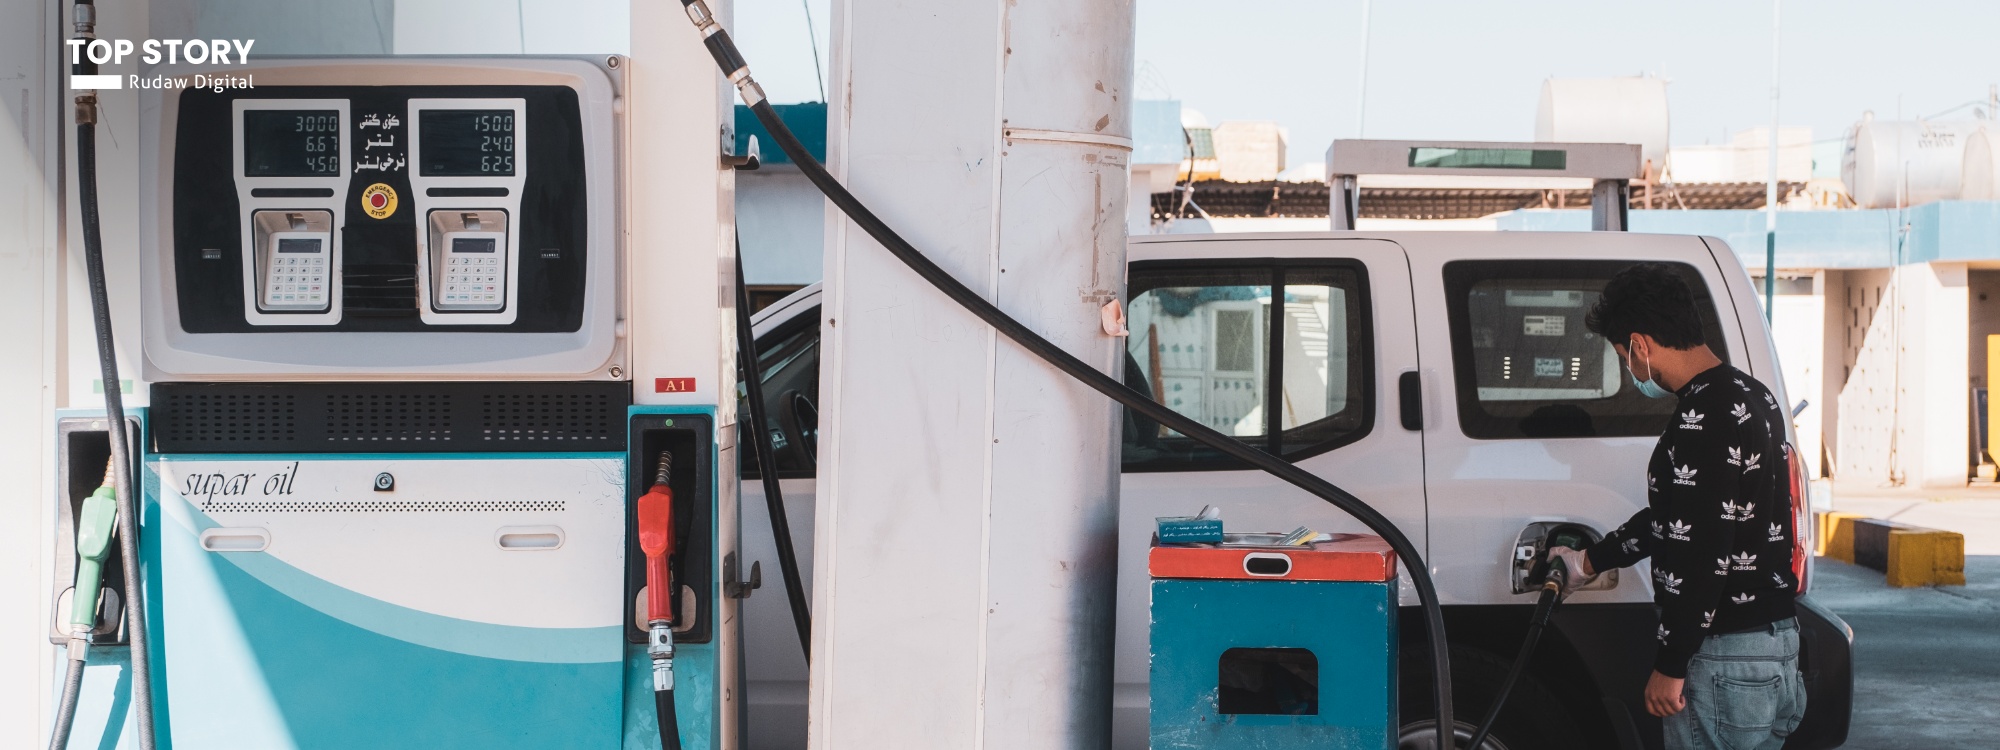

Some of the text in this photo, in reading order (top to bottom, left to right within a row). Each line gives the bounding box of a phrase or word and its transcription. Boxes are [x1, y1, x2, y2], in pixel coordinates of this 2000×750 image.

[295, 115, 338, 132] 3000
[475, 115, 513, 132] 1500
[306, 136, 338, 152] 6.67
[481, 135, 513, 152] 2.40
[306, 156, 338, 172] 450
[481, 156, 513, 172] 625
[365, 185, 395, 200] EMERGENCY
[370, 209, 387, 217] STOP
[1679, 423, 1703, 431] adidas
[181, 461, 299, 506] supar oil
